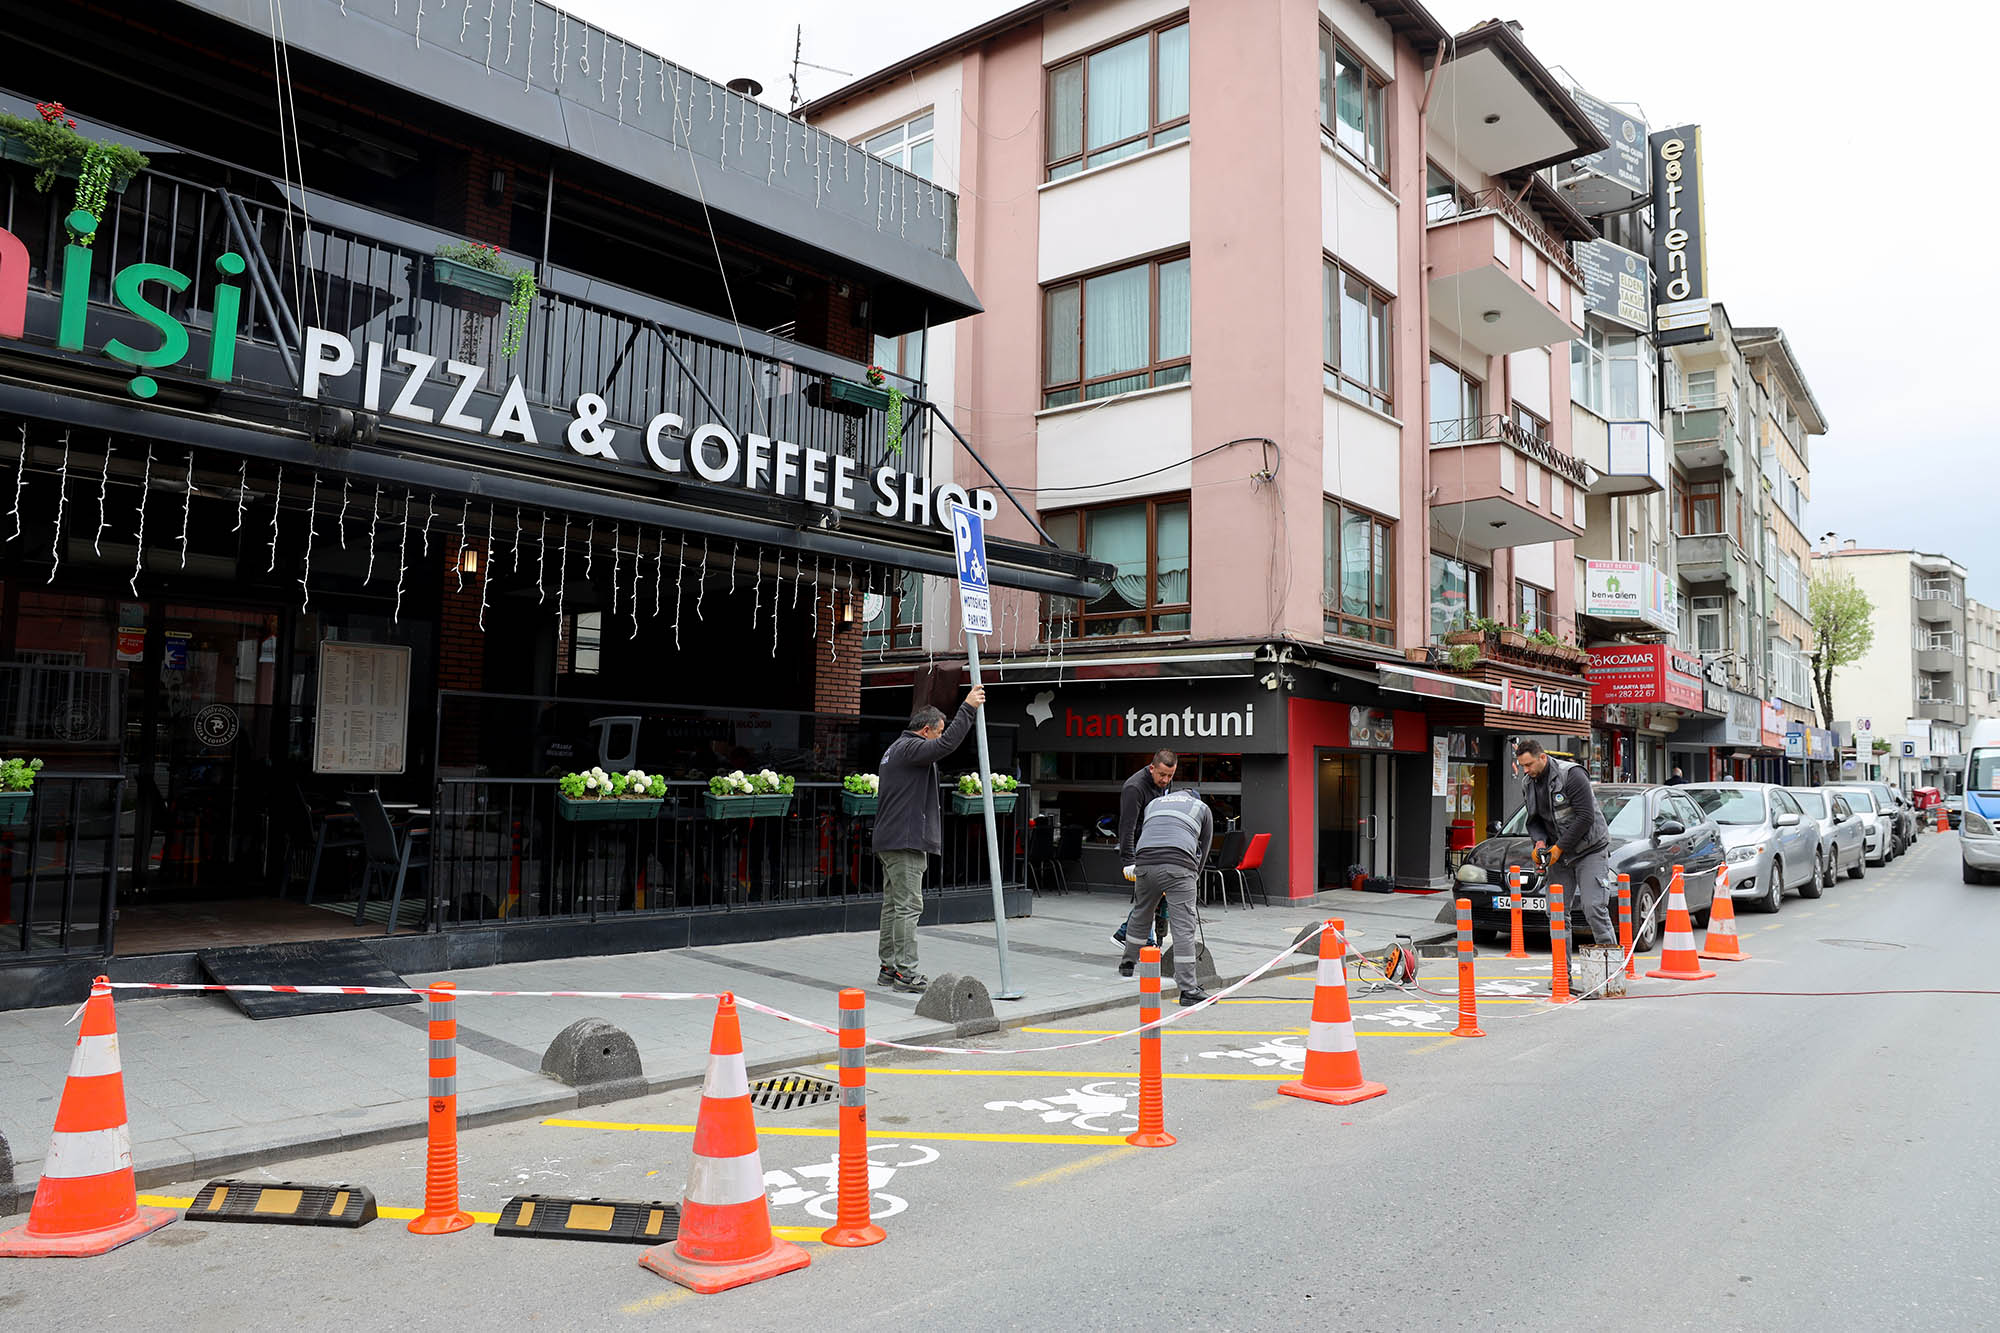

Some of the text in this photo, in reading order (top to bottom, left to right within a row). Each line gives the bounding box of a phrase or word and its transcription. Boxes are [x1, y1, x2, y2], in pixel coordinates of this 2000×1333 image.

[1620, 273, 1643, 293] ELDEN
[301, 326, 539, 444] PIZZA
[566, 392, 619, 460] &
[643, 411, 856, 510] COFFEE
[872, 465, 998, 532] SHOP
[954, 511, 972, 573] P
[1603, 653, 1654, 664] KOZMAR
[1618, 690, 1633, 698] 282
[1645, 689, 1656, 697] 67
[1905, 744, 1913, 754] D
